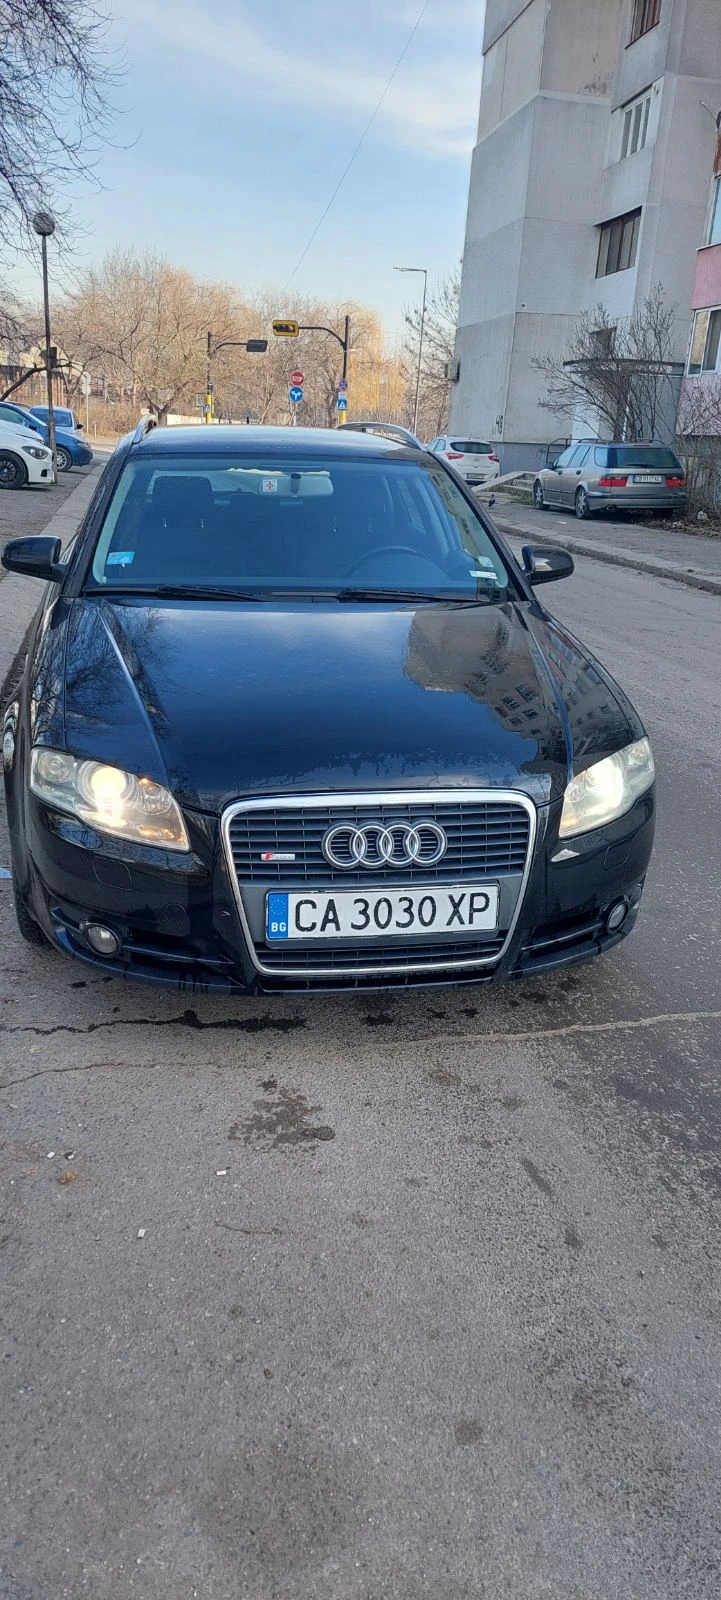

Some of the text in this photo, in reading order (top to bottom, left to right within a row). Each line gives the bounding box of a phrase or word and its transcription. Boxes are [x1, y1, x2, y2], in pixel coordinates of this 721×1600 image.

[295, 892, 490, 932] CA 3030 XP
[271, 922, 287, 933] BG
